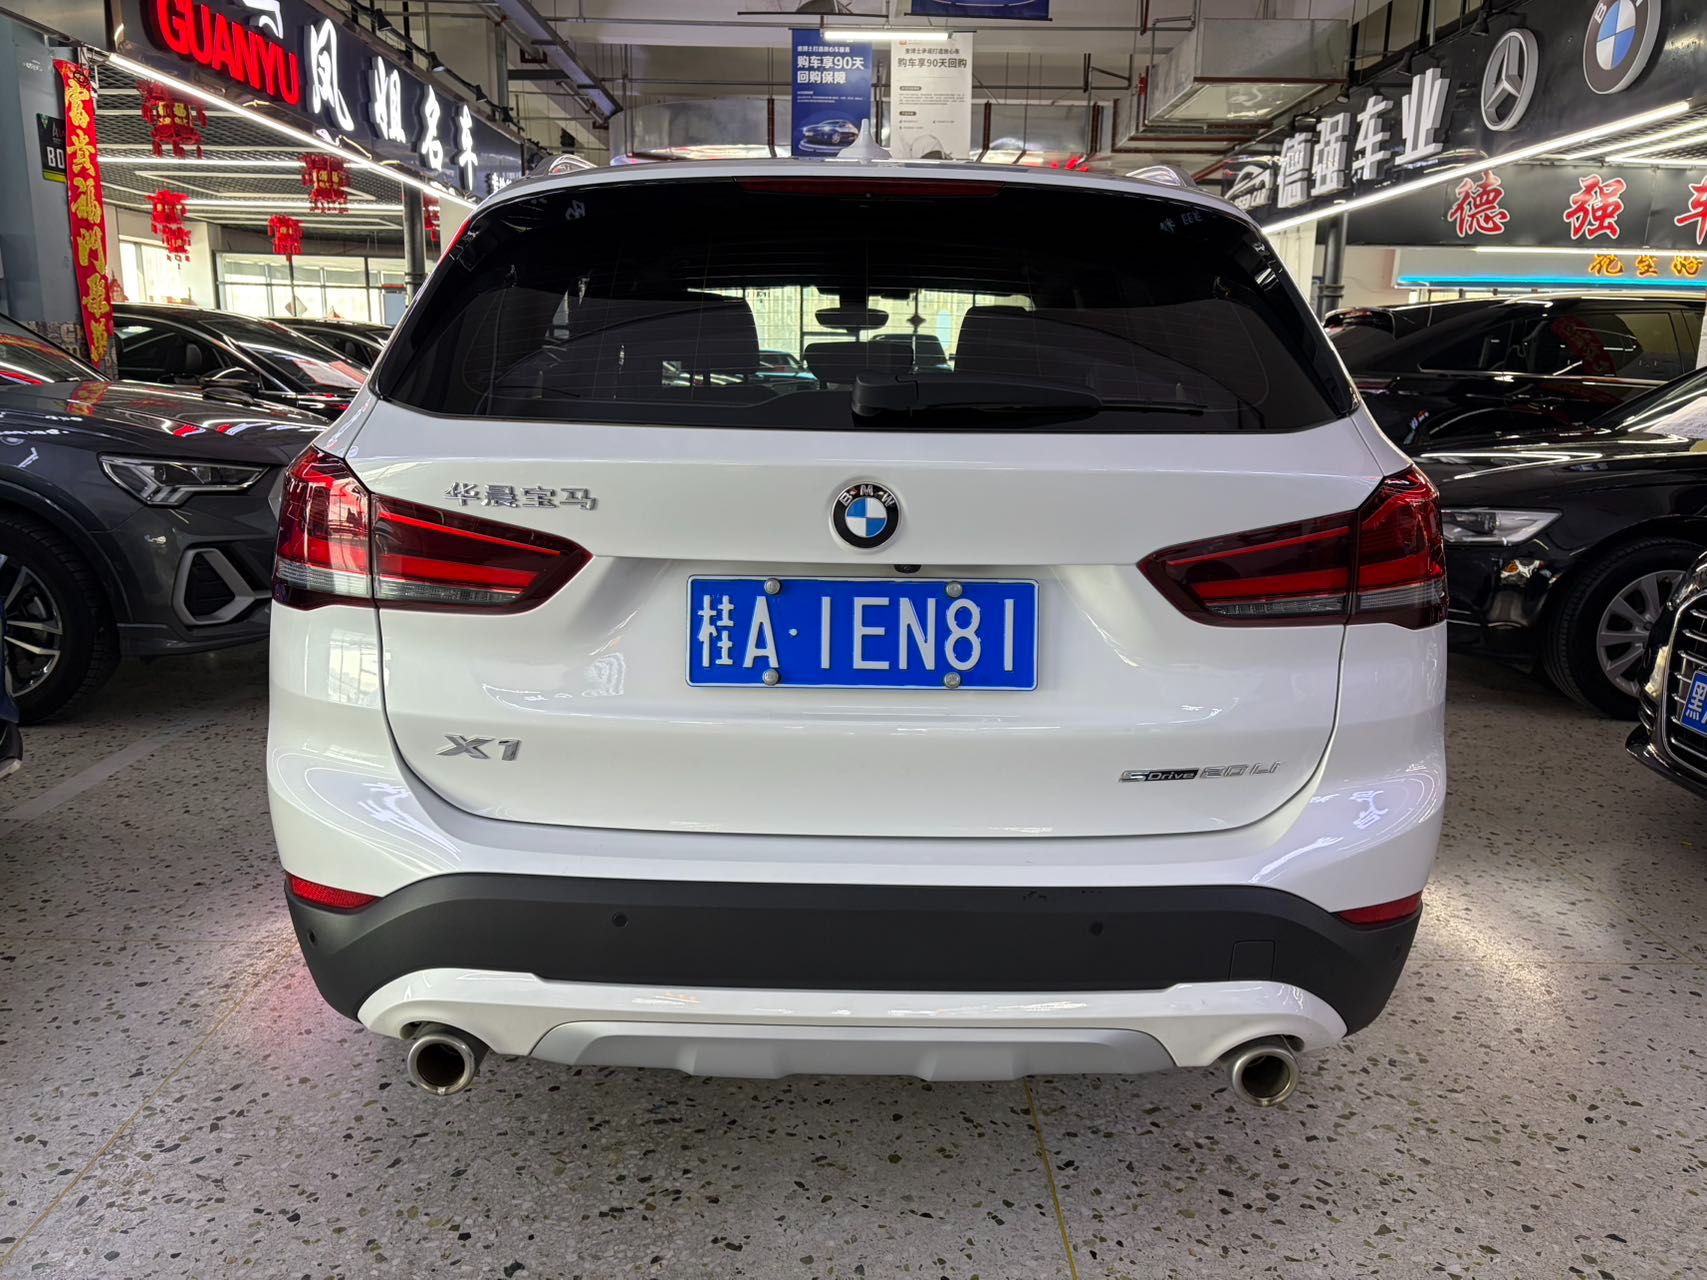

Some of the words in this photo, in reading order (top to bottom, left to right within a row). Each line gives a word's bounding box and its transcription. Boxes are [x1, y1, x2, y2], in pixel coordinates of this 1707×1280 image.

[157, 0, 299, 105] GUANYU
[797, 55, 865, 70] 购车享90天
[897, 57, 967, 69] 购车享90天回购
[797, 70, 847, 84] 回购保障
[1277, 67, 1450, 209] 德强车业
[443, 481, 599, 511] 华晨宝马
[839, 484, 895, 507] BMW
[435, 734, 522, 762] X1
